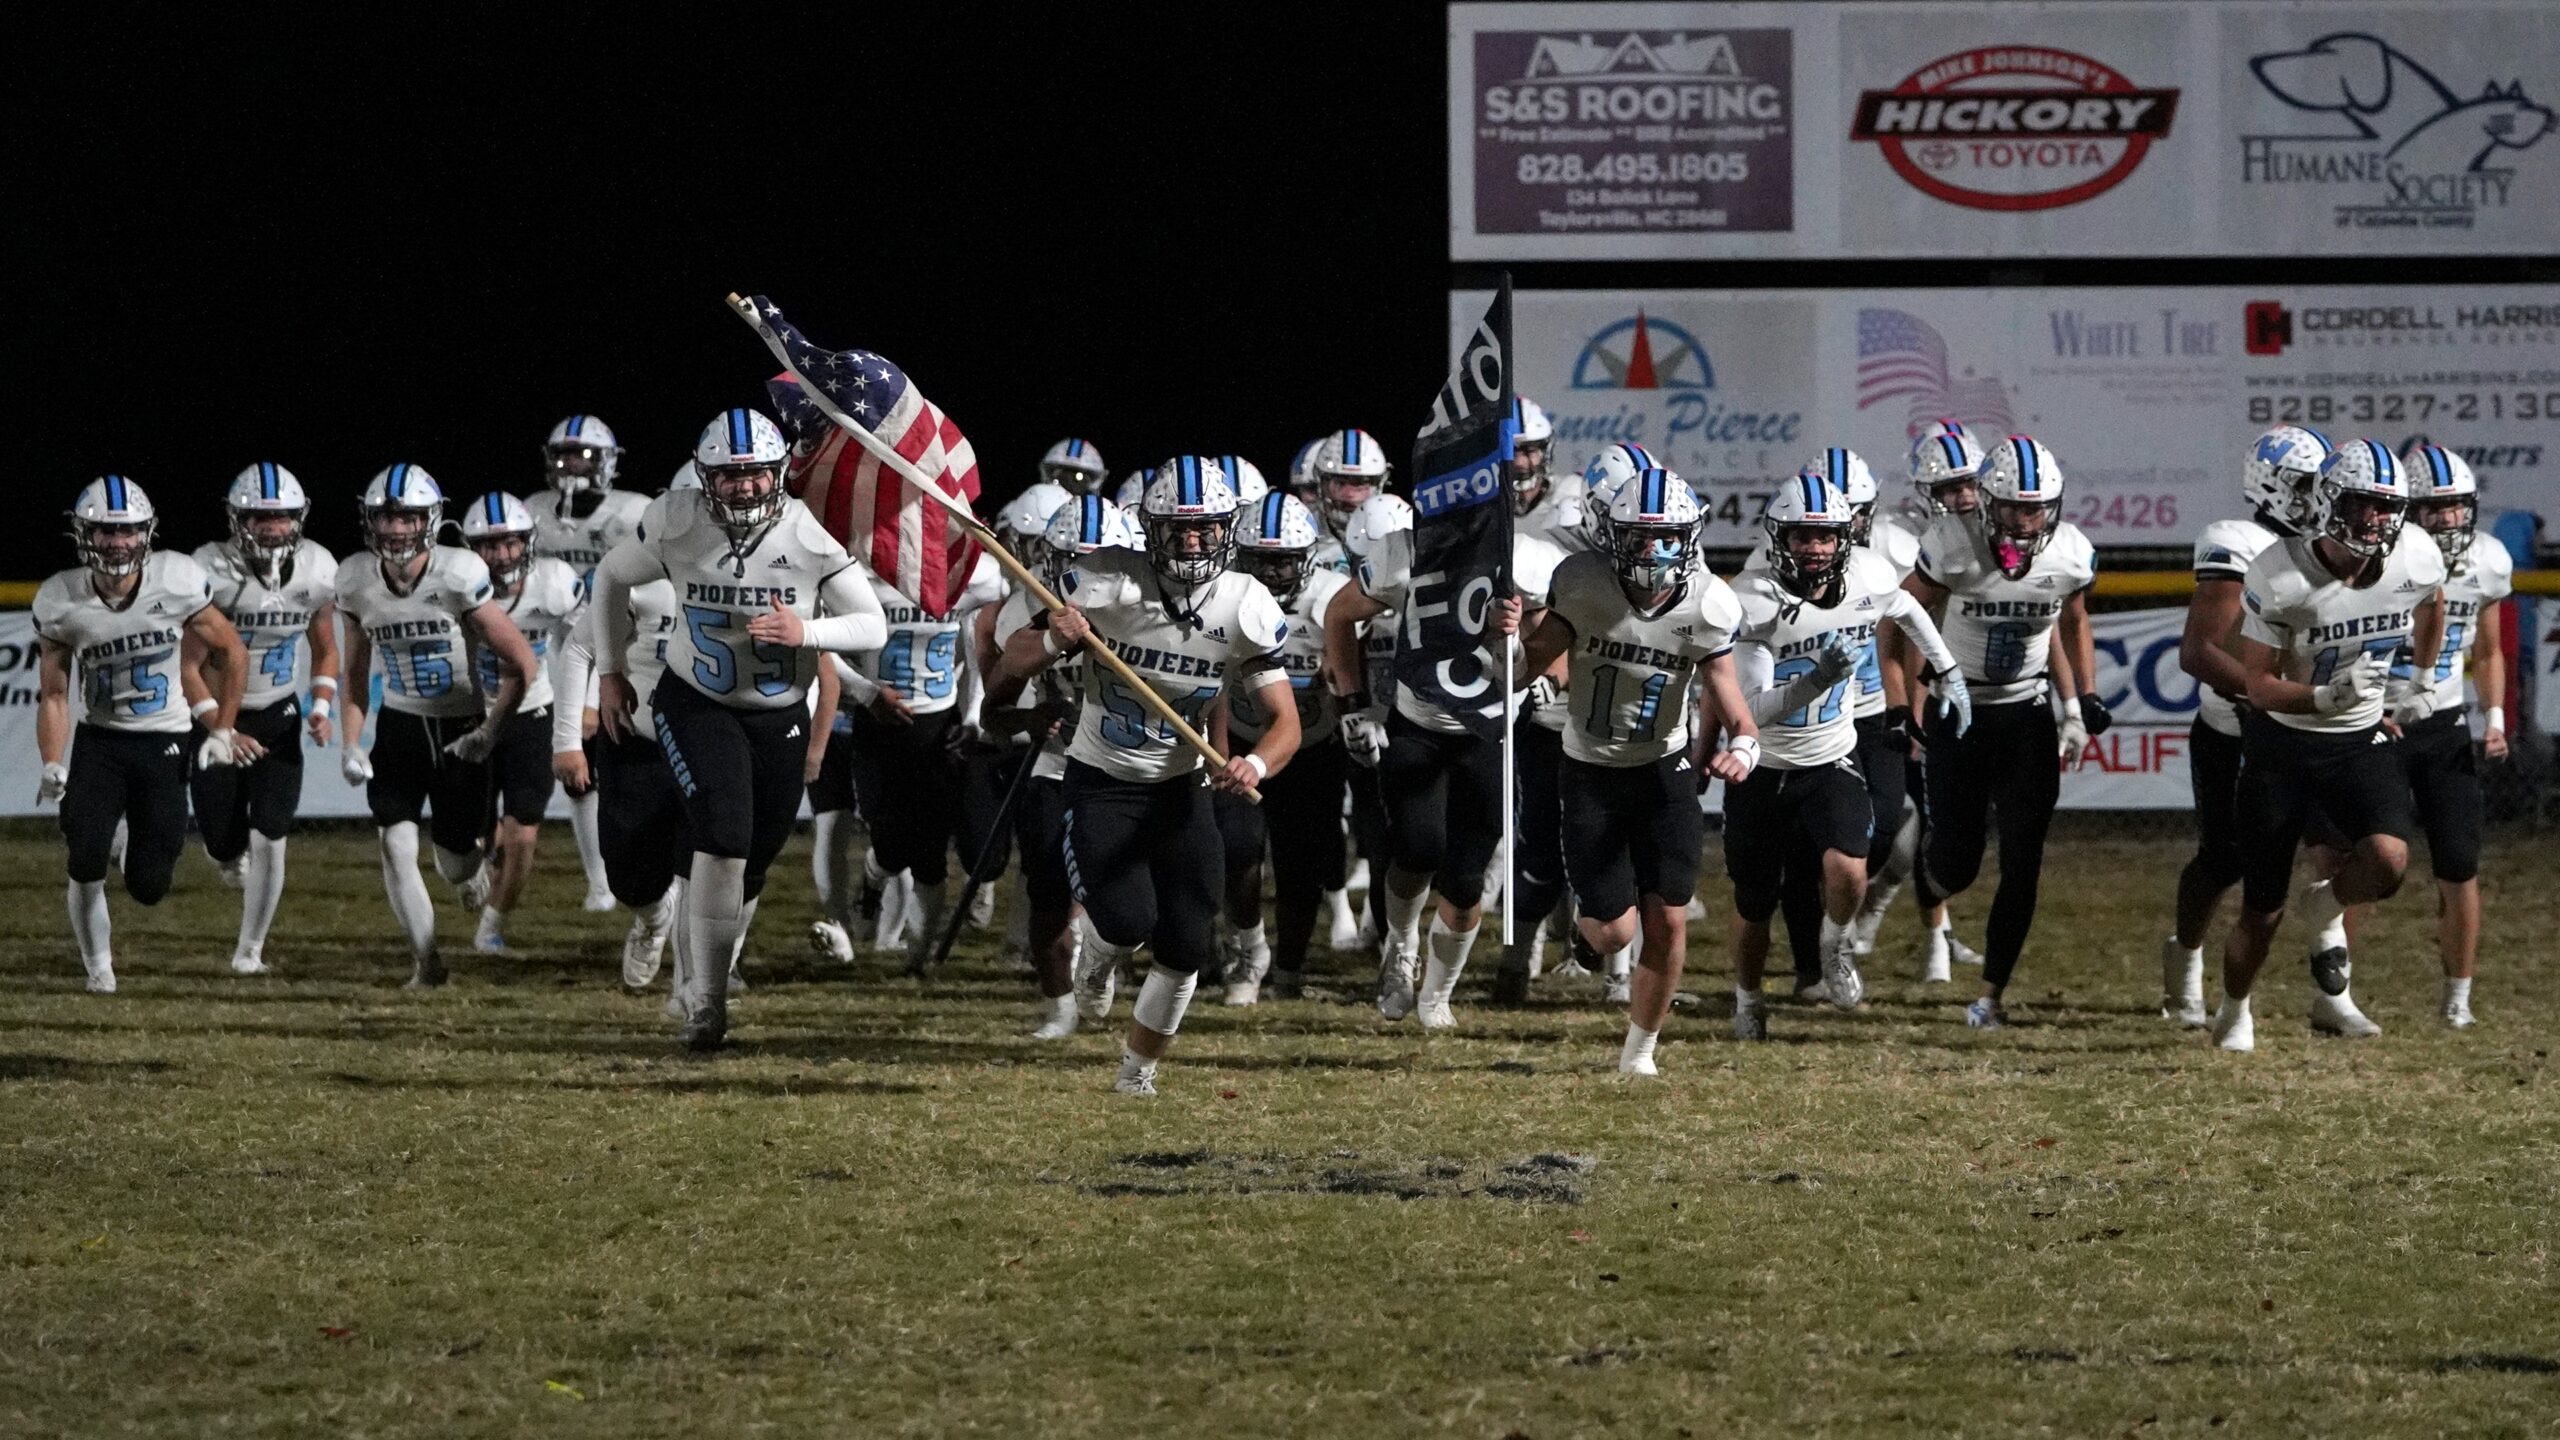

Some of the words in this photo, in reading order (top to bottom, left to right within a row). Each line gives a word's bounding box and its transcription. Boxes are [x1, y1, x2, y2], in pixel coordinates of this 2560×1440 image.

[1916, 54, 1974, 90] MIKE
[1985, 51, 2110, 89] JOHNSON'S
[1486, 86, 1569, 122] S&S
[1578, 85, 1781, 121] ROOFING
[1874, 98, 2156, 132] HICKORY
[1518, 153, 1749, 184] 828.495.1805
[1968, 143, 2103, 168] TOYOTA
[2303, 307, 2444, 330] CORDELL
[1663, 391, 1800, 448] Pierce
[686, 582, 796, 607] PIONEERS
[1961, 599, 2061, 617] PIONEERS
[81, 626, 178, 662] PIONEERS
[367, 620, 451, 643] PIONEERS
[2307, 609, 2410, 644] PIONEERS
[683, 604, 797, 698] 55
[1106, 637, 1226, 679] PIONEERS
[1586, 635, 1690, 673] PIONEERS
[1585, 663, 1669, 742] 11
